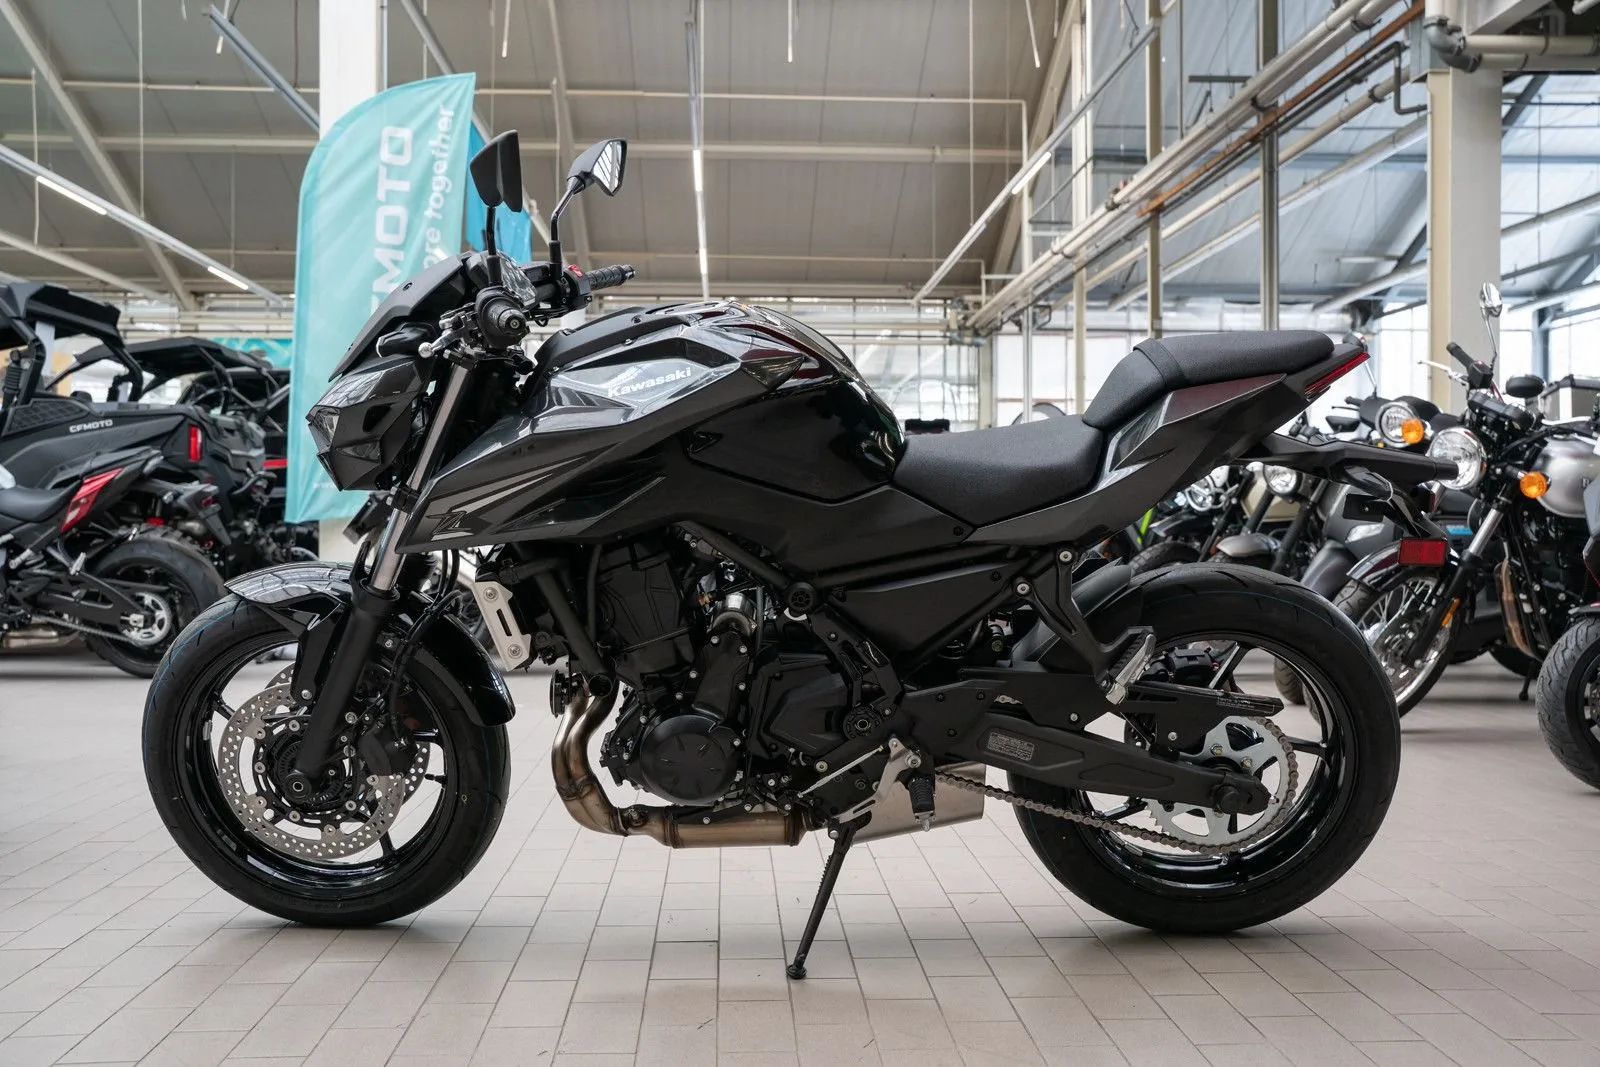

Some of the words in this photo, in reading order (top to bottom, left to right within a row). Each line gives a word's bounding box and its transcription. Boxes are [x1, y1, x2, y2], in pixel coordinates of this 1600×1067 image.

[424, 104, 455, 219] together
[423, 229, 441, 269] ore
[607, 367, 691, 398] Kawasaki
[69, 419, 113, 433] CFMOTO
